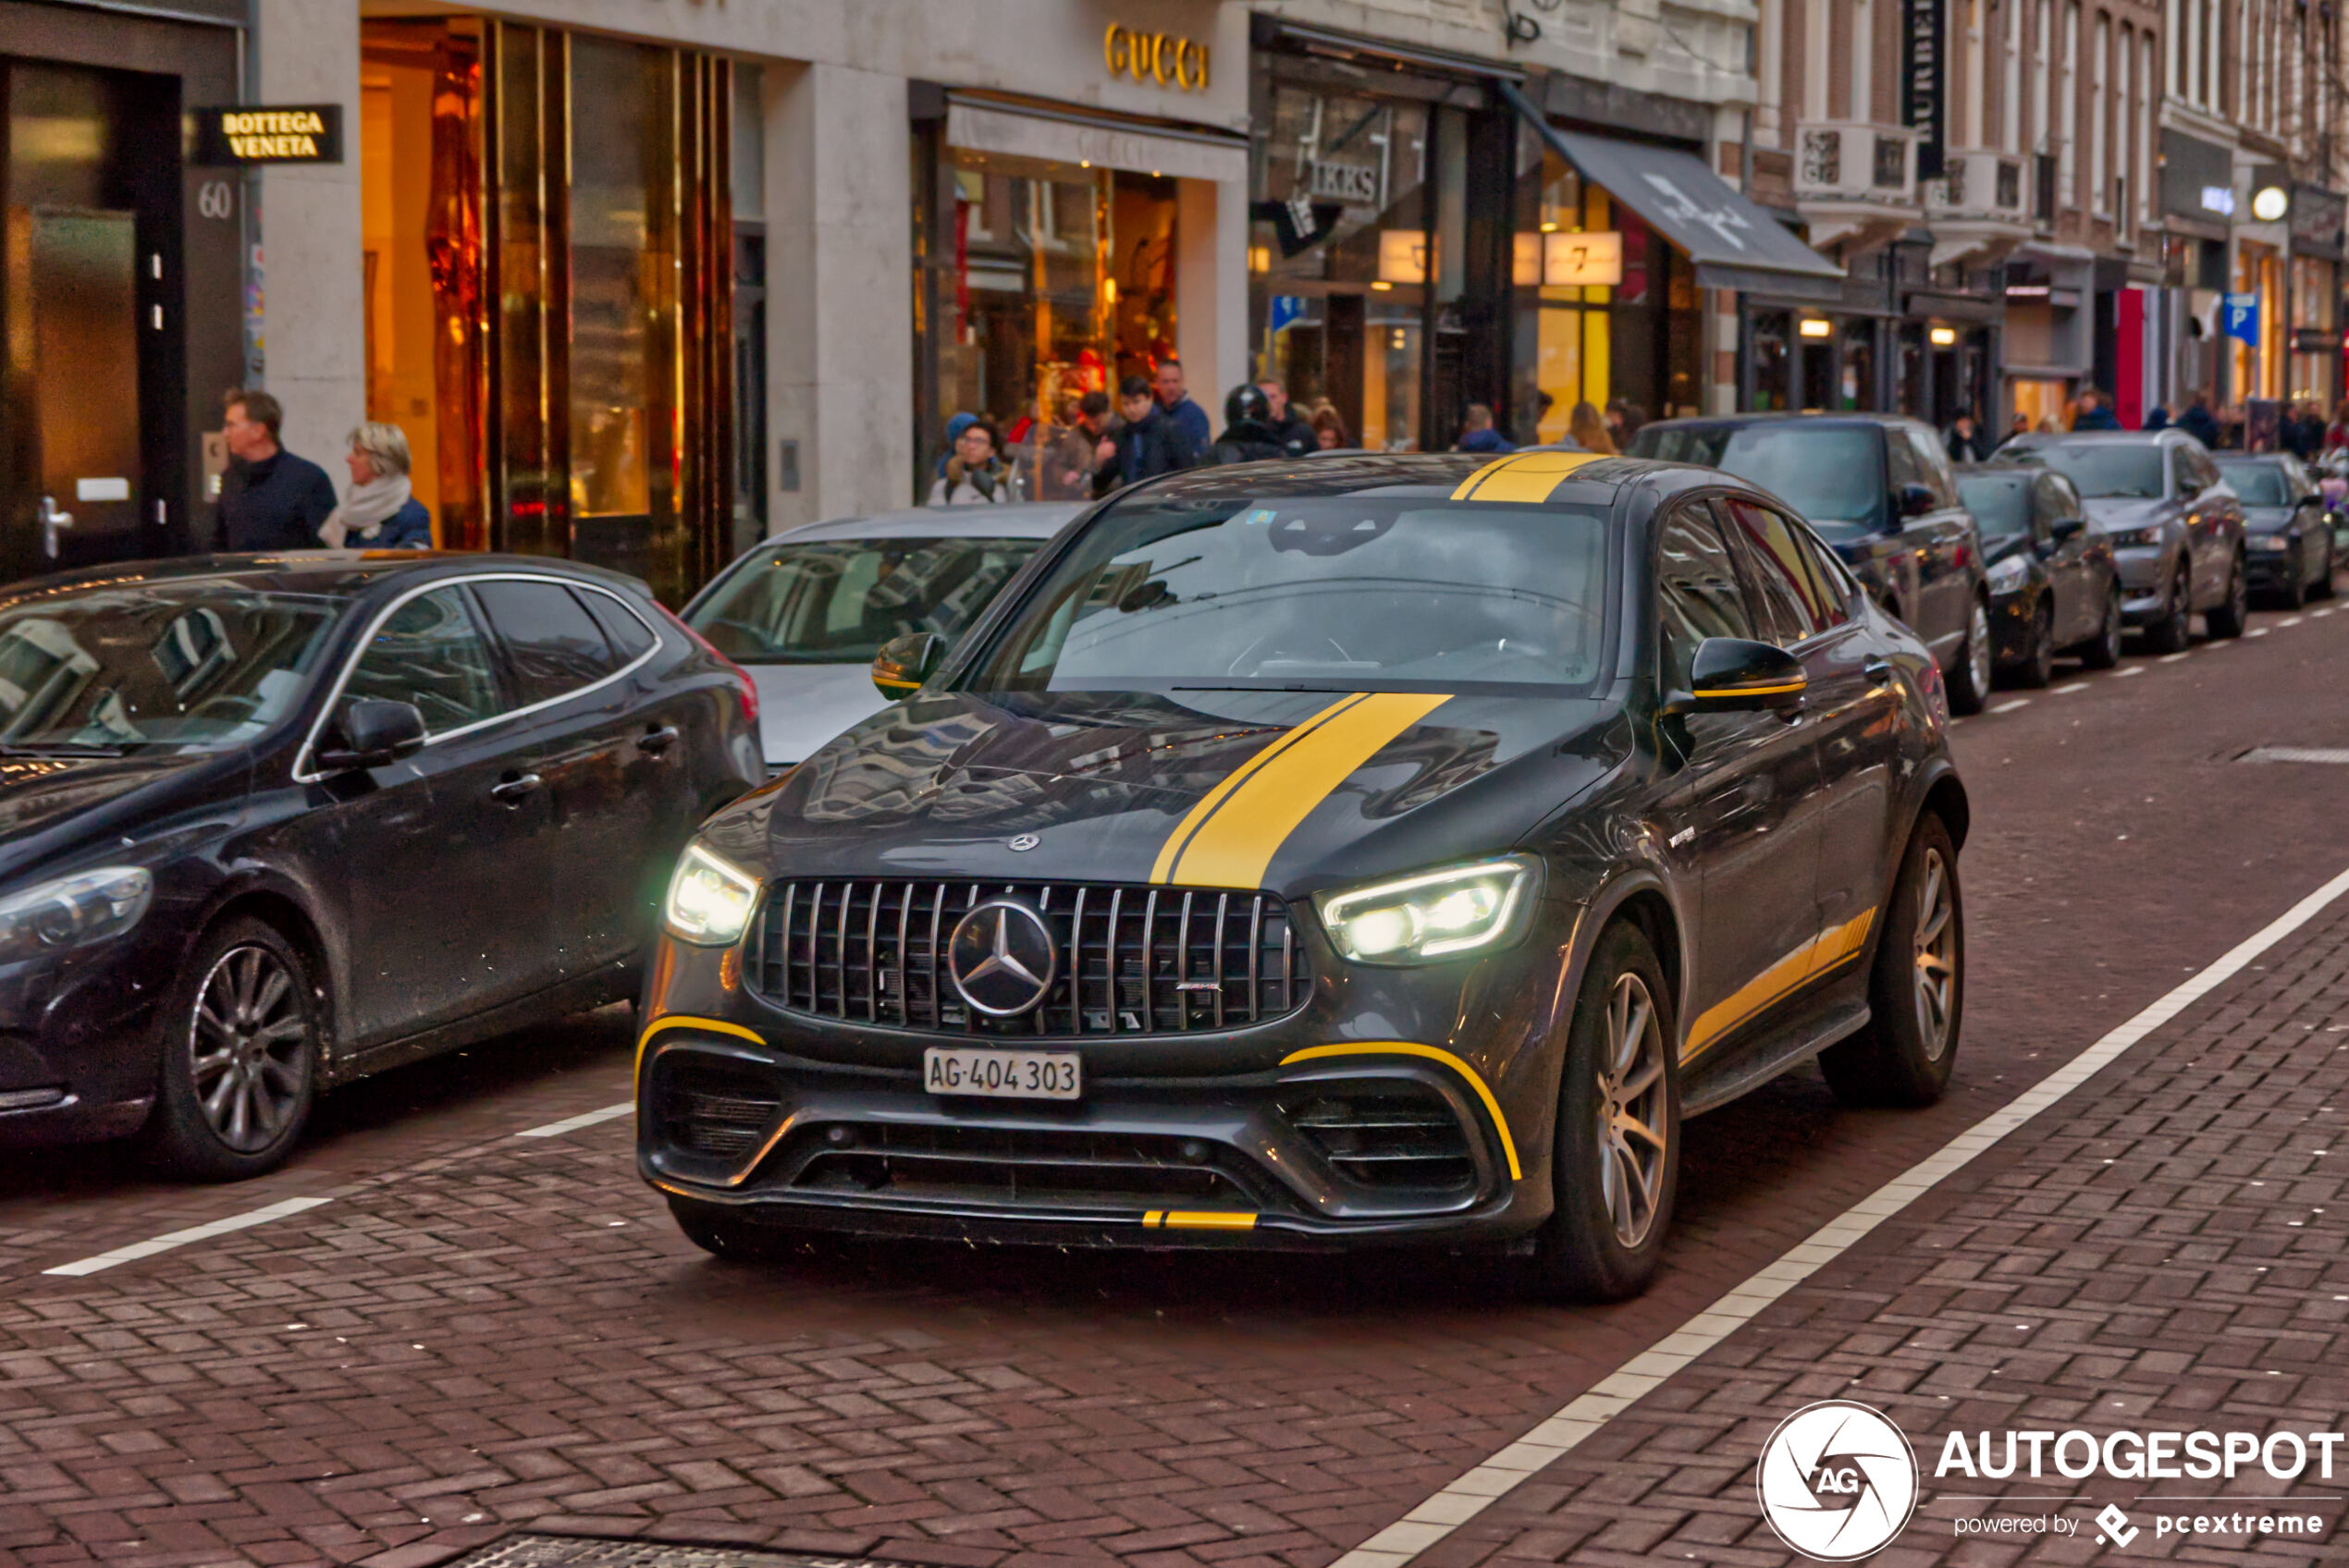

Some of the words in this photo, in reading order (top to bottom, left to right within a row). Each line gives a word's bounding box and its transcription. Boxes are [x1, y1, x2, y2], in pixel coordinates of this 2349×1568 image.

[1104, 22, 1209, 90] GUCCI
[222, 111, 325, 135] BOTTEGA
[228, 134, 318, 157] VENETA
[1311, 160, 1375, 202] IKKS
[199, 181, 231, 219] 60
[2232, 307, 2247, 330] P
[1026, 1060, 1075, 1092] 303
